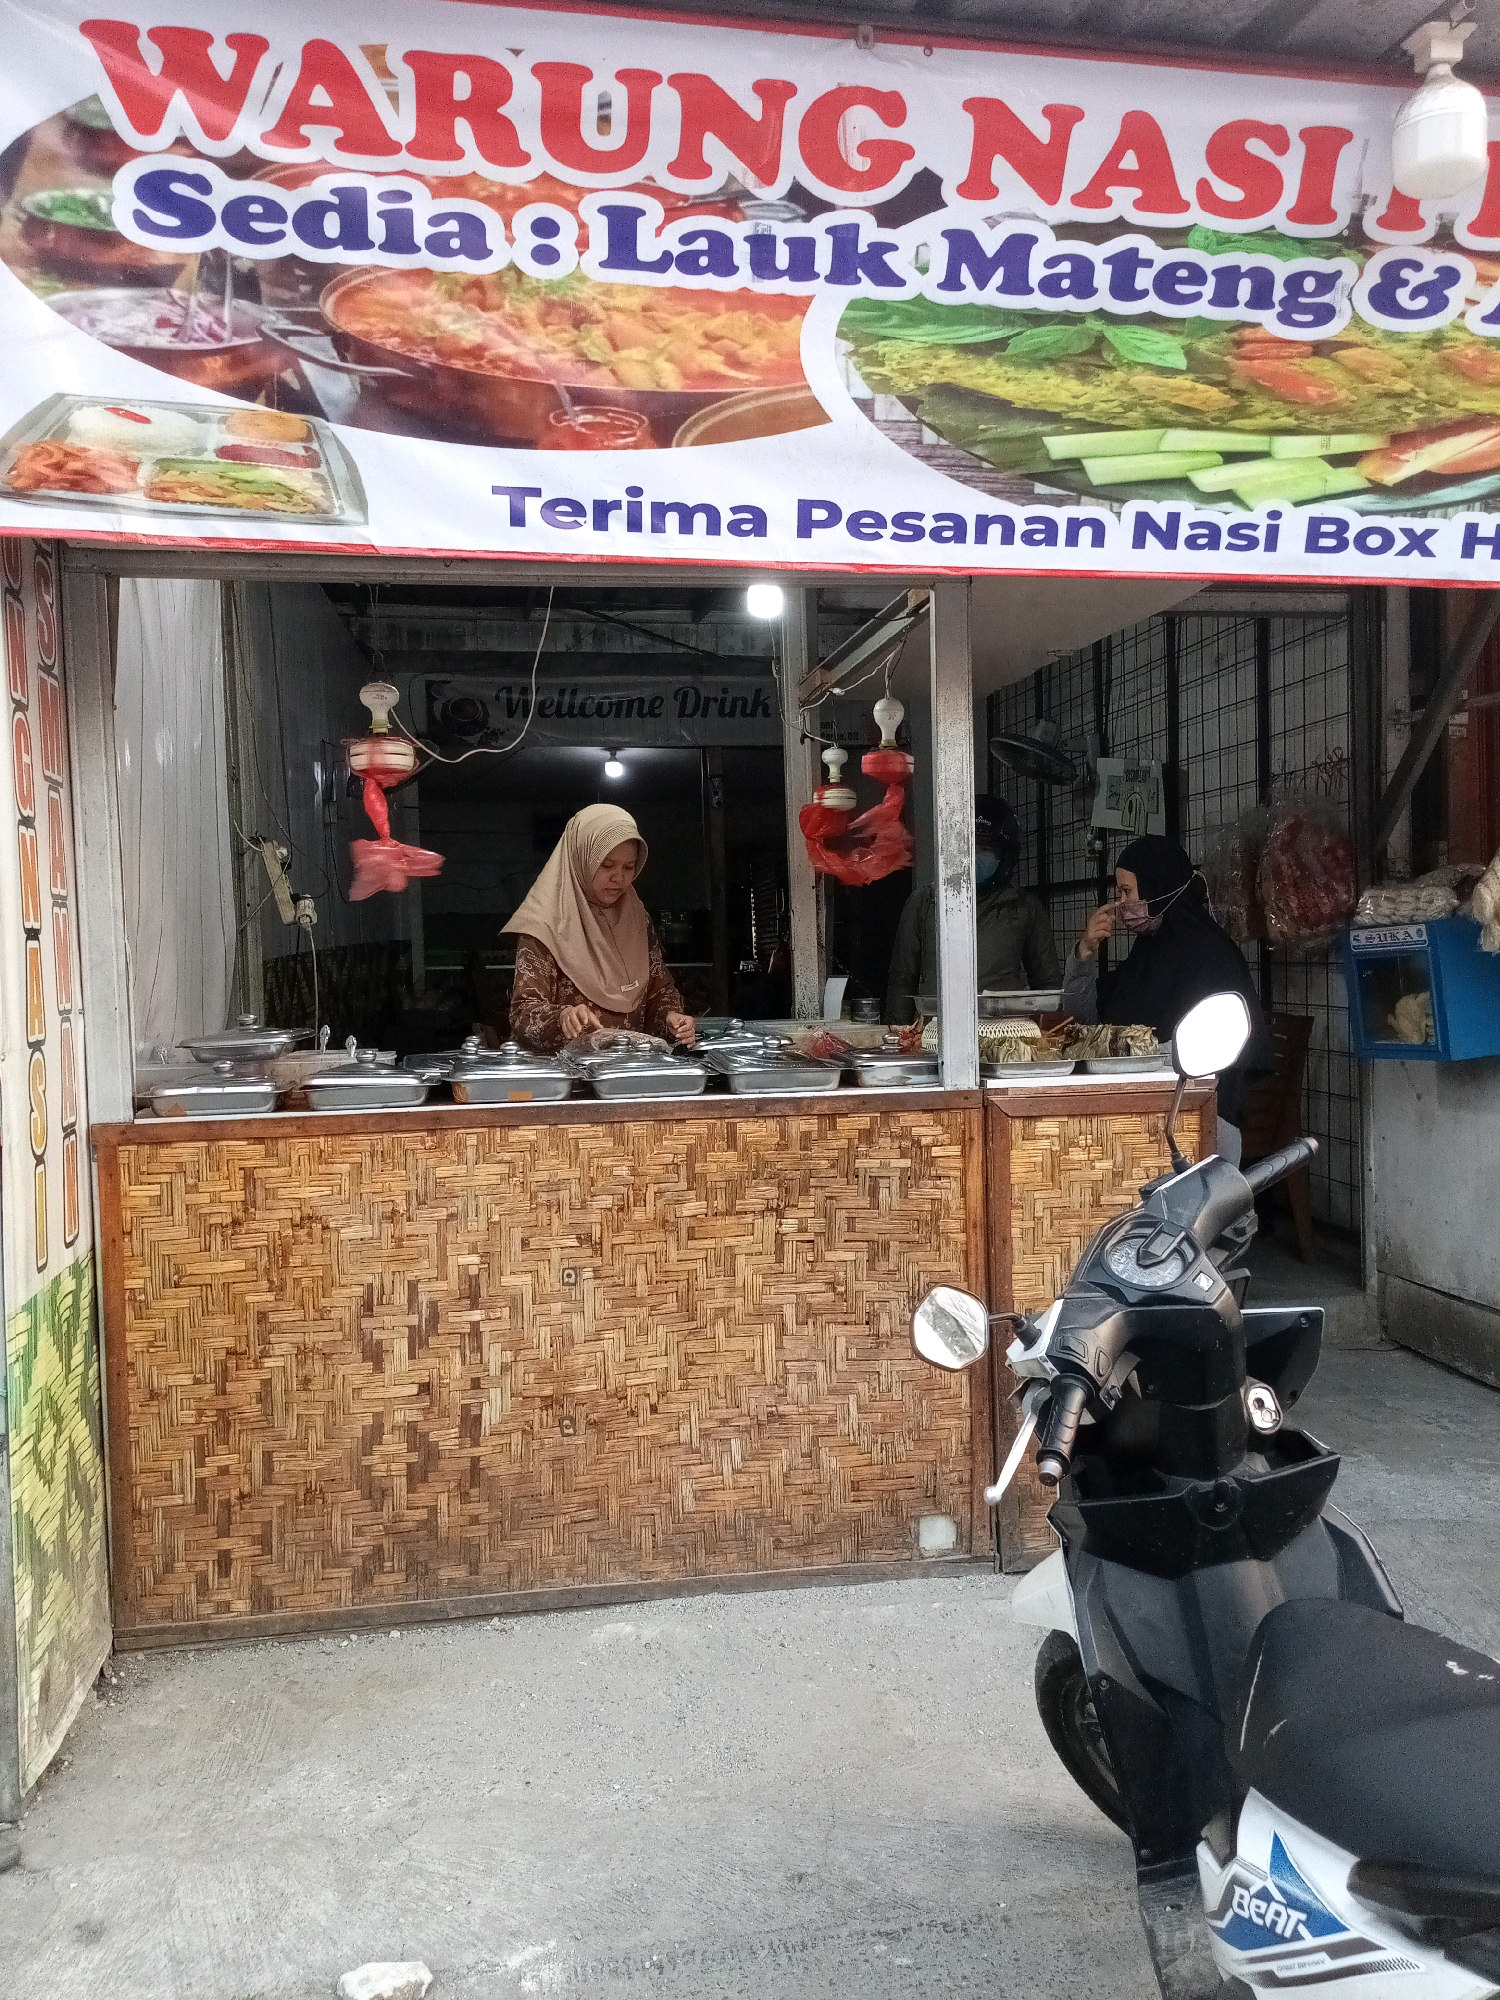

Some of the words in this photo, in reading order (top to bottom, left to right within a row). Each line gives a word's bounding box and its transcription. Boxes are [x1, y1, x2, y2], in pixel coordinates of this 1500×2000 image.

[80, 18, 916, 192] WARUNG
[955, 96, 1354, 226] NASI
[132, 168, 493, 261] Sedia
[597, 204, 907, 289] Lauk
[938, 228, 1342, 329] Mateng
[1367, 258, 1462, 321] &
[492, 486, 768, 537] Terima
[796, 498, 1106, 549] Pesanan
[1131, 509, 1283, 553] Nasi
[1304, 516, 1440, 558] Box
[494, 685, 664, 719] Wellcome
[673, 685, 772, 719] Drink
